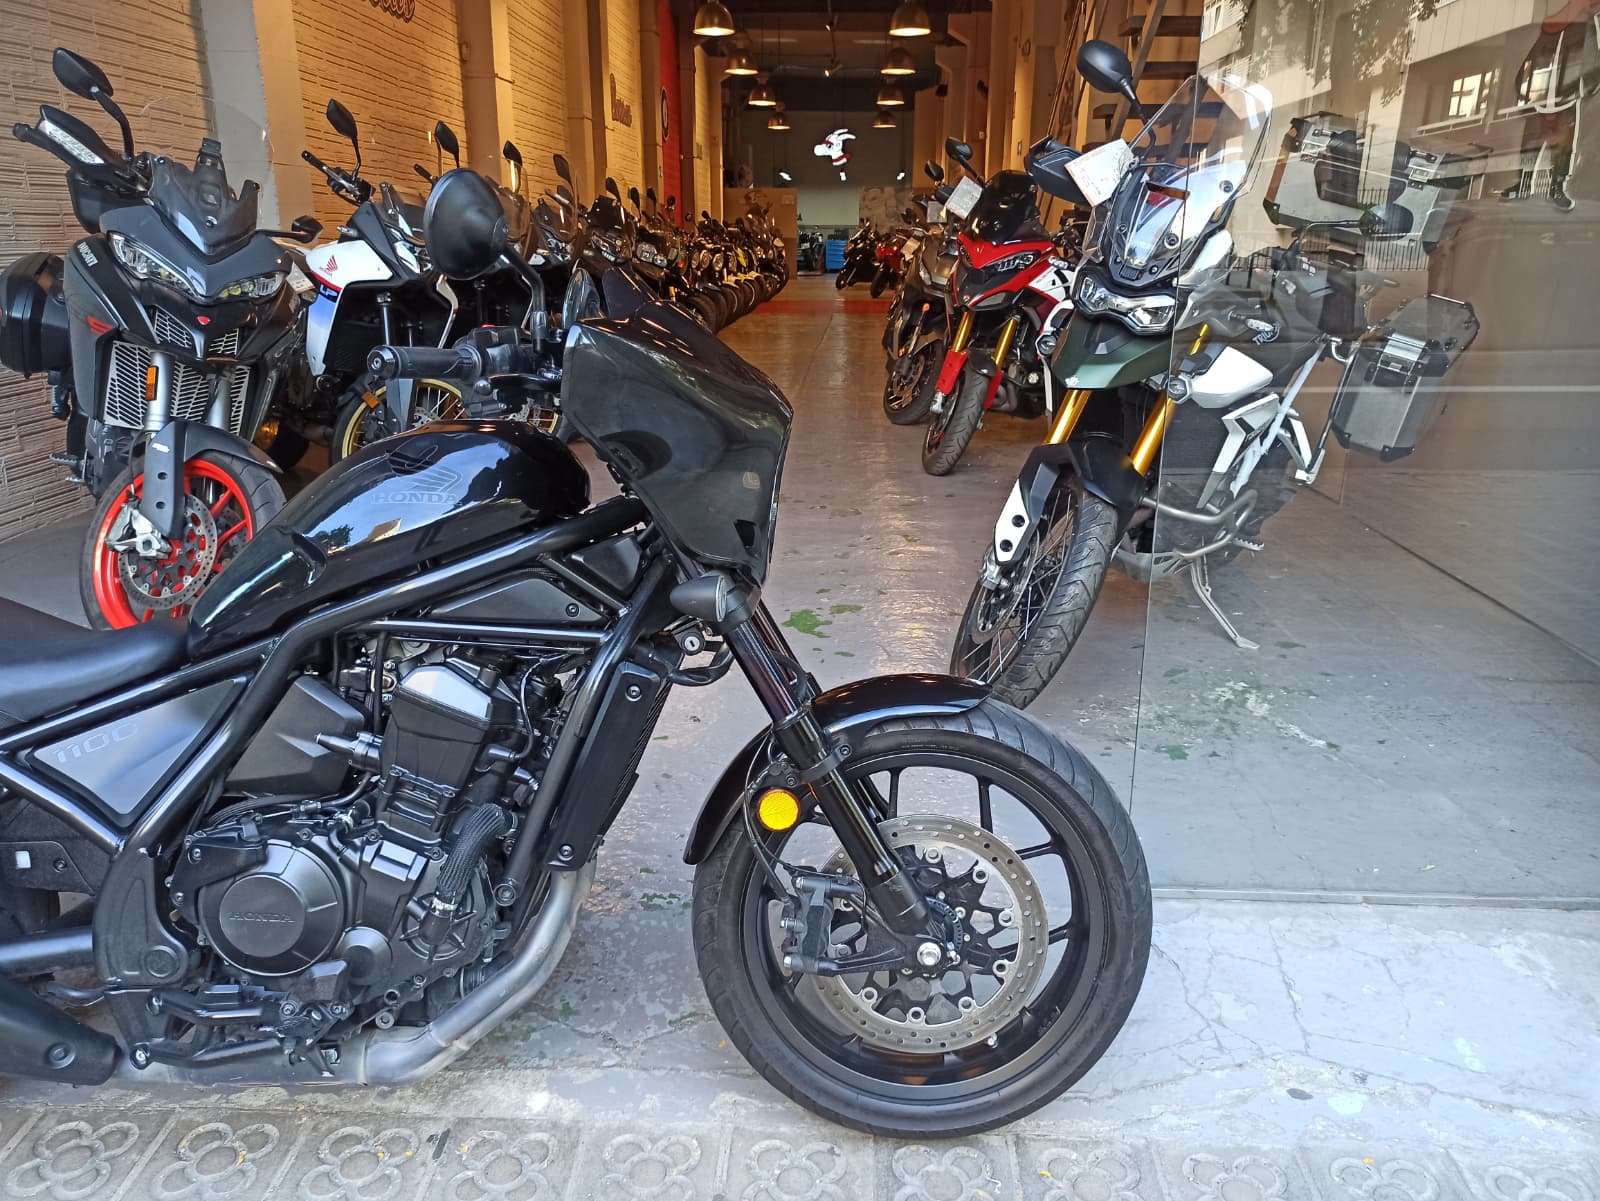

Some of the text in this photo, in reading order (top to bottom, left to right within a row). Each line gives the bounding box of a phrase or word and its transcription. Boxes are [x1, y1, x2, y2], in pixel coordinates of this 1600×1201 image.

[77, 241, 99, 267] DUCATI
[370, 491, 462, 505] HONDA
[53, 723, 138, 763] 1100
[228, 911, 296, 924] HONDA
